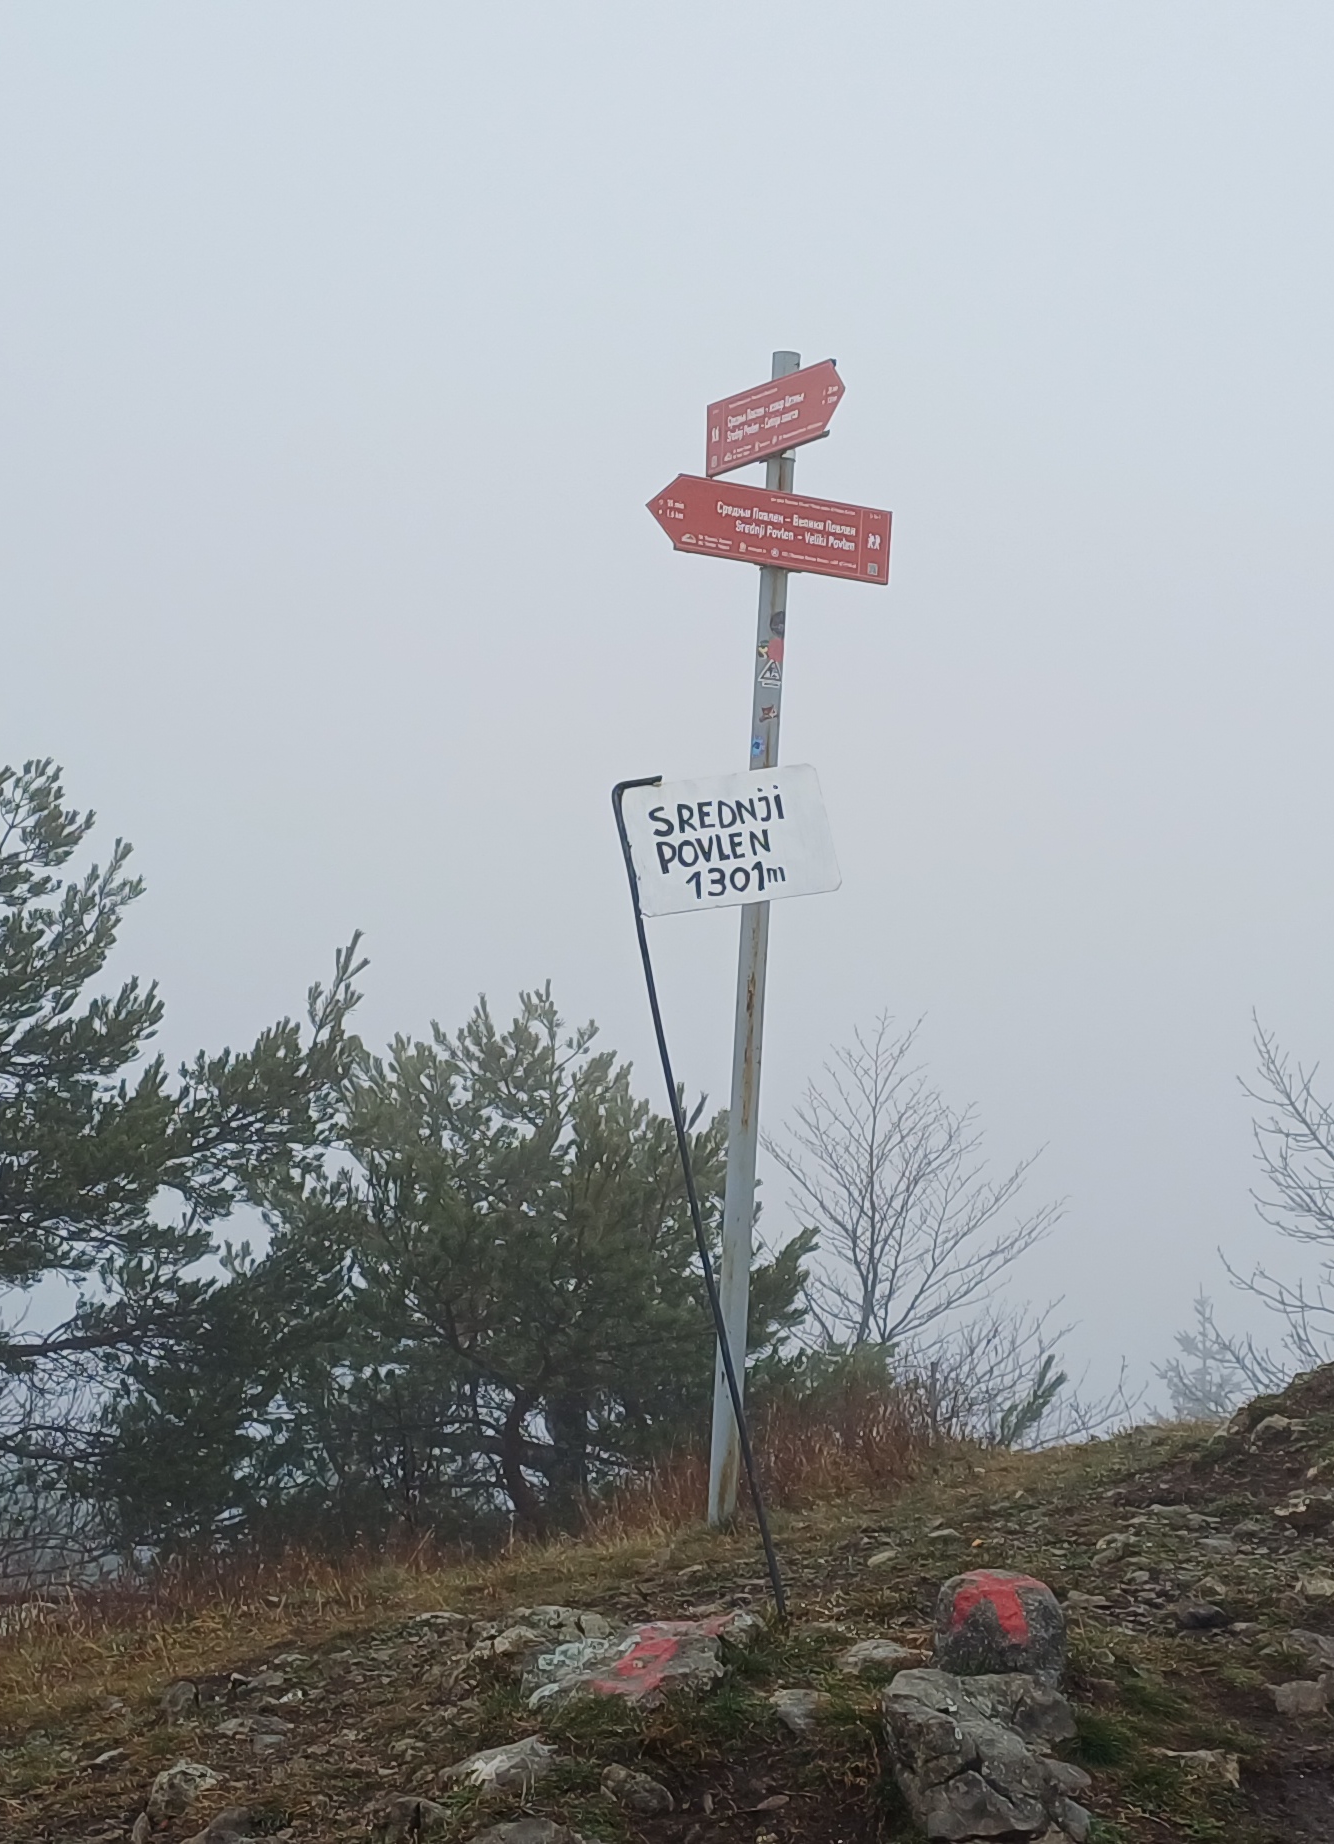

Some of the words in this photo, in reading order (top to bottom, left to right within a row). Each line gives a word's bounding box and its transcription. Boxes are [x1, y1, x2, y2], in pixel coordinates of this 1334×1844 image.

[735, 520, 765, 538] Srednji
[767, 525, 794, 540] Povlen
[805, 531, 827, 547] Veliki
[828, 535, 856, 551] Povlen
[648, 785, 785, 837] SREDNJI
[656, 829, 772, 875] POVLEN
[686, 861, 786, 900] 1301m
